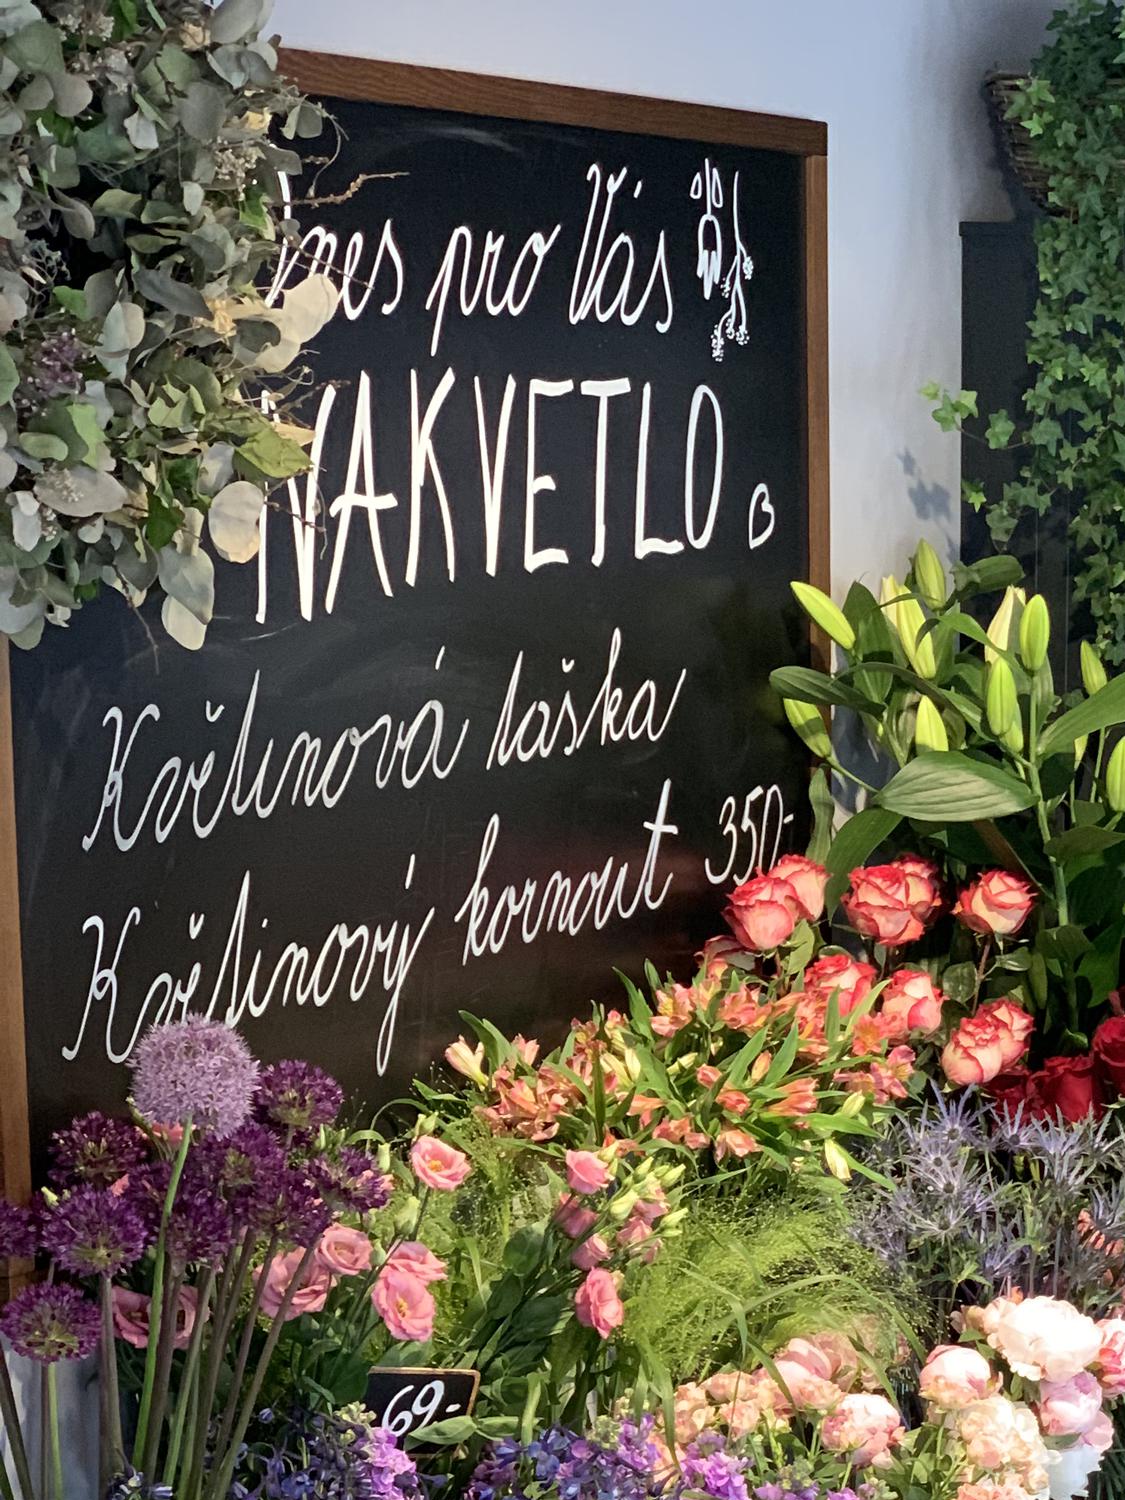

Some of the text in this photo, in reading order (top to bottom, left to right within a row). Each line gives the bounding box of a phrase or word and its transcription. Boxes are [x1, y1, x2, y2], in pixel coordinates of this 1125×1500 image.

[424, 224, 562, 357] pro
[569, 163, 673, 333] Vás
[255, 366, 724, 624] NAKVETLO
[454, 778, 678, 966] kornout
